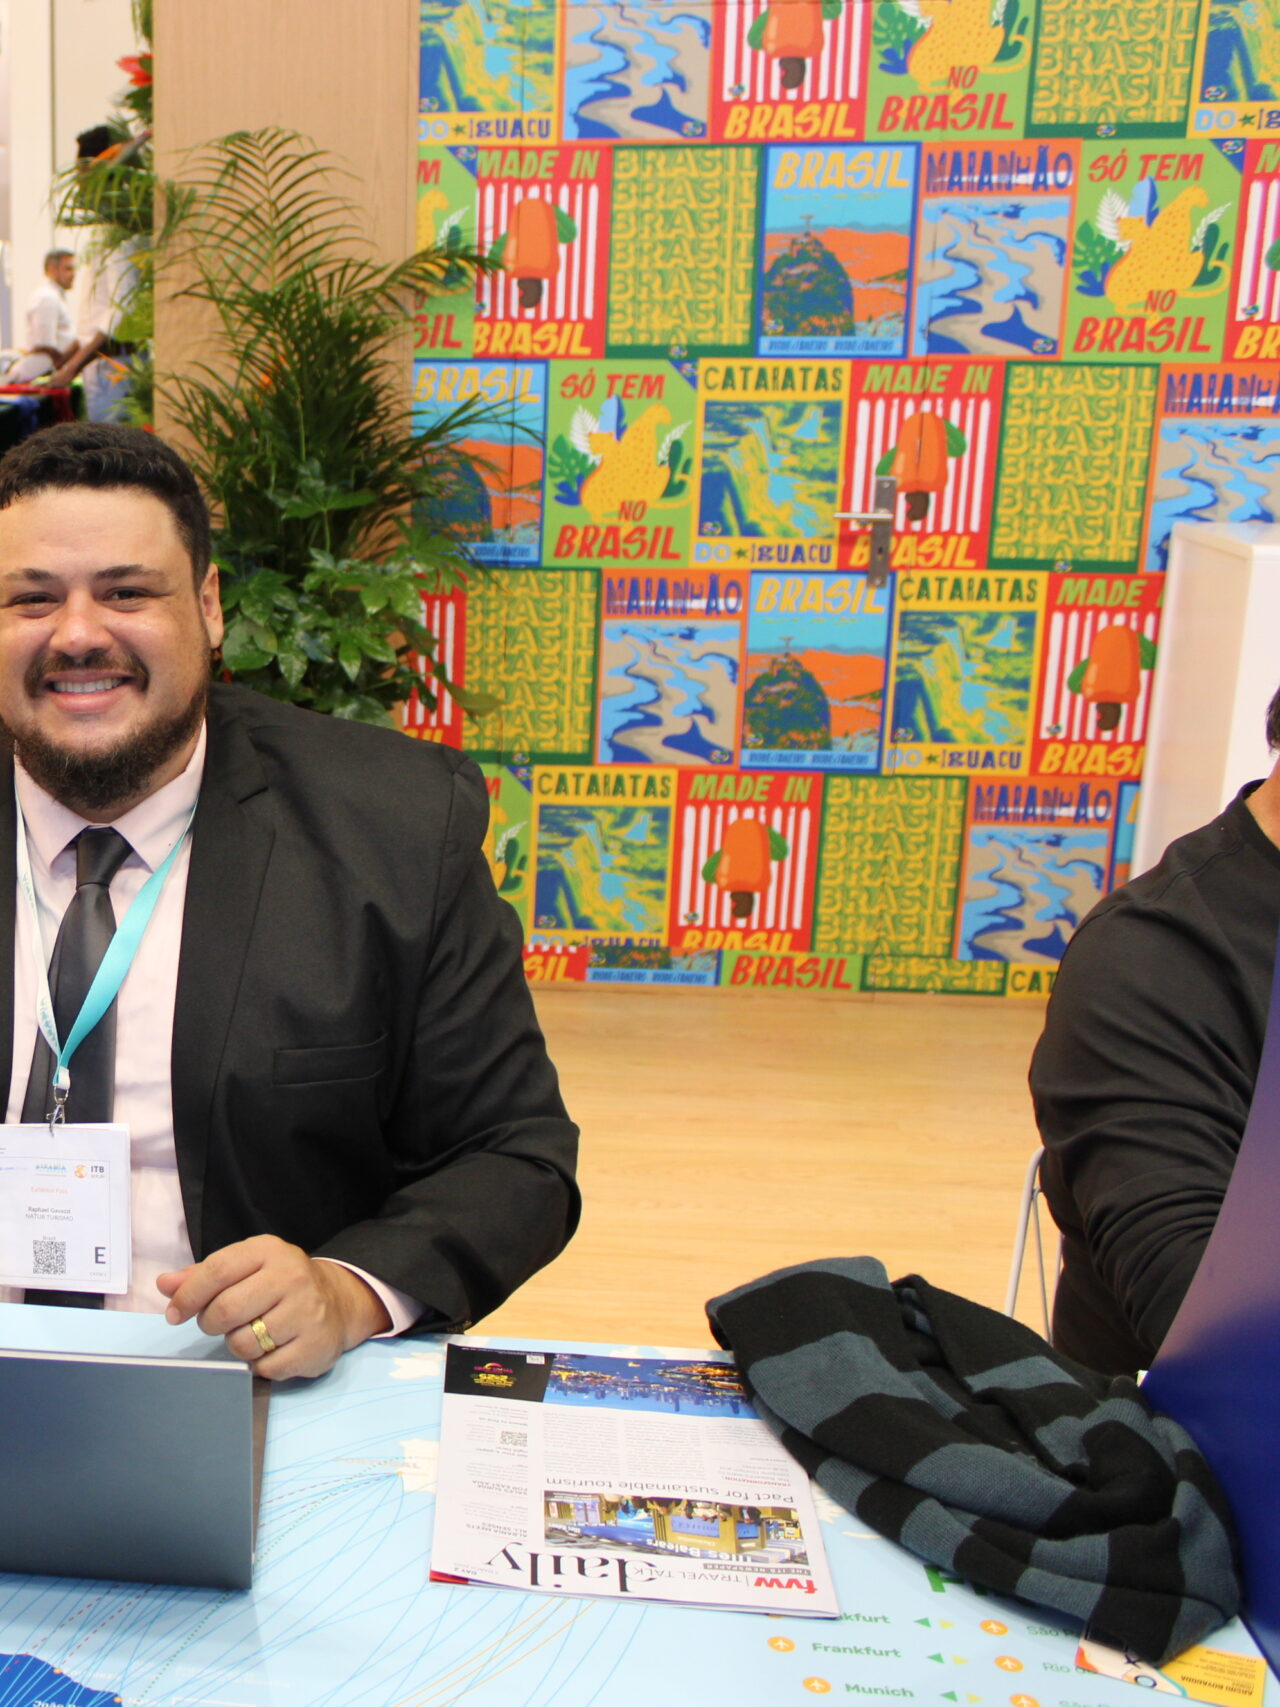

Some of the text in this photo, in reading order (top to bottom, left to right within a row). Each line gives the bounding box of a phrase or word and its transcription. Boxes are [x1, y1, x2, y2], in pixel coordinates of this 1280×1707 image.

[948, 65, 978, 88] NO
[723, 105, 856, 138] BRASIL
[877, 93, 1015, 132] BRASIL
[1194, 109, 1235, 131] DO
[477, 150, 601, 179] MADE IN
[773, 151, 909, 189] BRASIL
[1088, 149, 1204, 182] SÓ TEM
[1144, 290, 1176, 312] NO
[474, 321, 592, 355] BRASIL
[1072, 316, 1211, 353] BRASIL
[415, 367, 541, 403] BRASIL
[560, 368, 665, 399] SÓ TEM
[703, 366, 843, 391] CATARATAS
[862, 365, 994, 394] MADE IN
[618, 500, 647, 522] NO
[554, 525, 681, 560] BRASIL
[694, 542, 732, 562] DO
[849, 536, 976, 568] BASIL
[754, 578, 886, 614] BRASIL
[898, 577, 1039, 602] CATARATAS
[1057, 578, 1147, 606] MADE
[885, 749, 922, 768] DO
[1039, 743, 1145, 776] BRASI
[537, 773, 671, 798] CATARATAS
[688, 775, 813, 803] MADE IN
[730, 955, 852, 990] BRASIL
[90, 1165, 105, 1173] ITB
[94, 1246, 107, 1264] E
[546, 1477, 795, 1503] Pact for sustainable tourism
[646, 1538, 701, 1557] Balears
[483, 1542, 656, 1593] daily
[631, 1567, 818, 1594] fvw TRAVEL TALK
[838, 1612, 891, 1624] kfurt
[1026, 1625, 1059, 1637] São
[811, 1642, 902, 1658] Frankfurt
[1042, 1662, 1071, 1674] Rio
[844, 1683, 915, 1698] Munich
